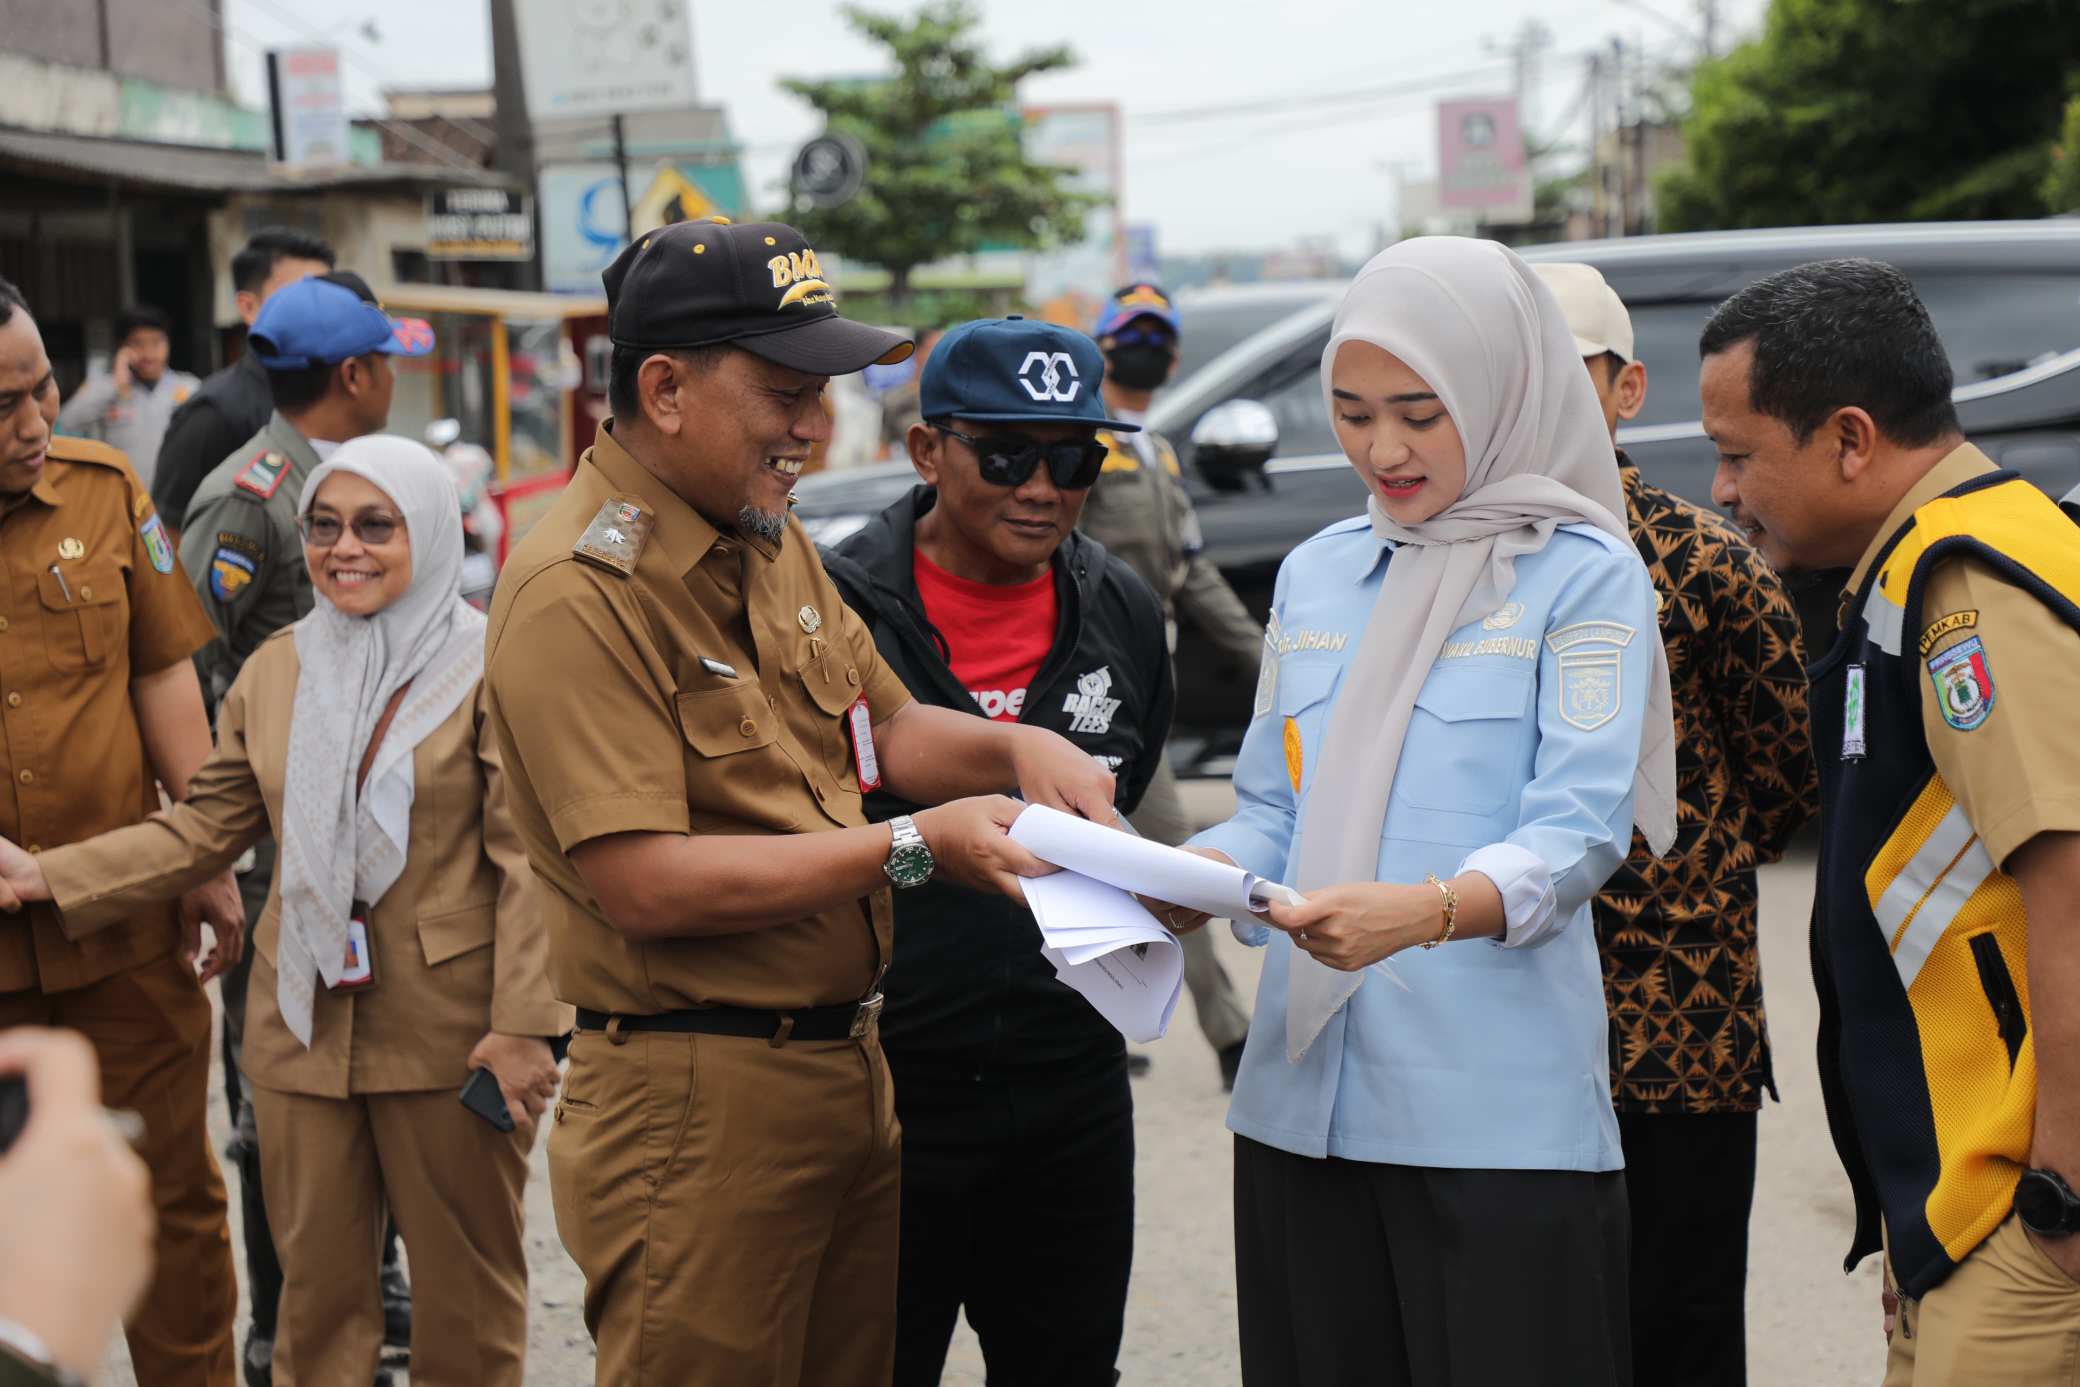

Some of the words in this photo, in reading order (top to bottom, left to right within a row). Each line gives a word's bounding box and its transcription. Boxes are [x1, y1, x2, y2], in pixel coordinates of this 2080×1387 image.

[1297, 630, 1346, 653] JIHAN
[1920, 614, 1971, 651] PEMKAB
[1474, 635, 1537, 659] GUBERNUR
[1069, 712, 1110, 734] TEES
